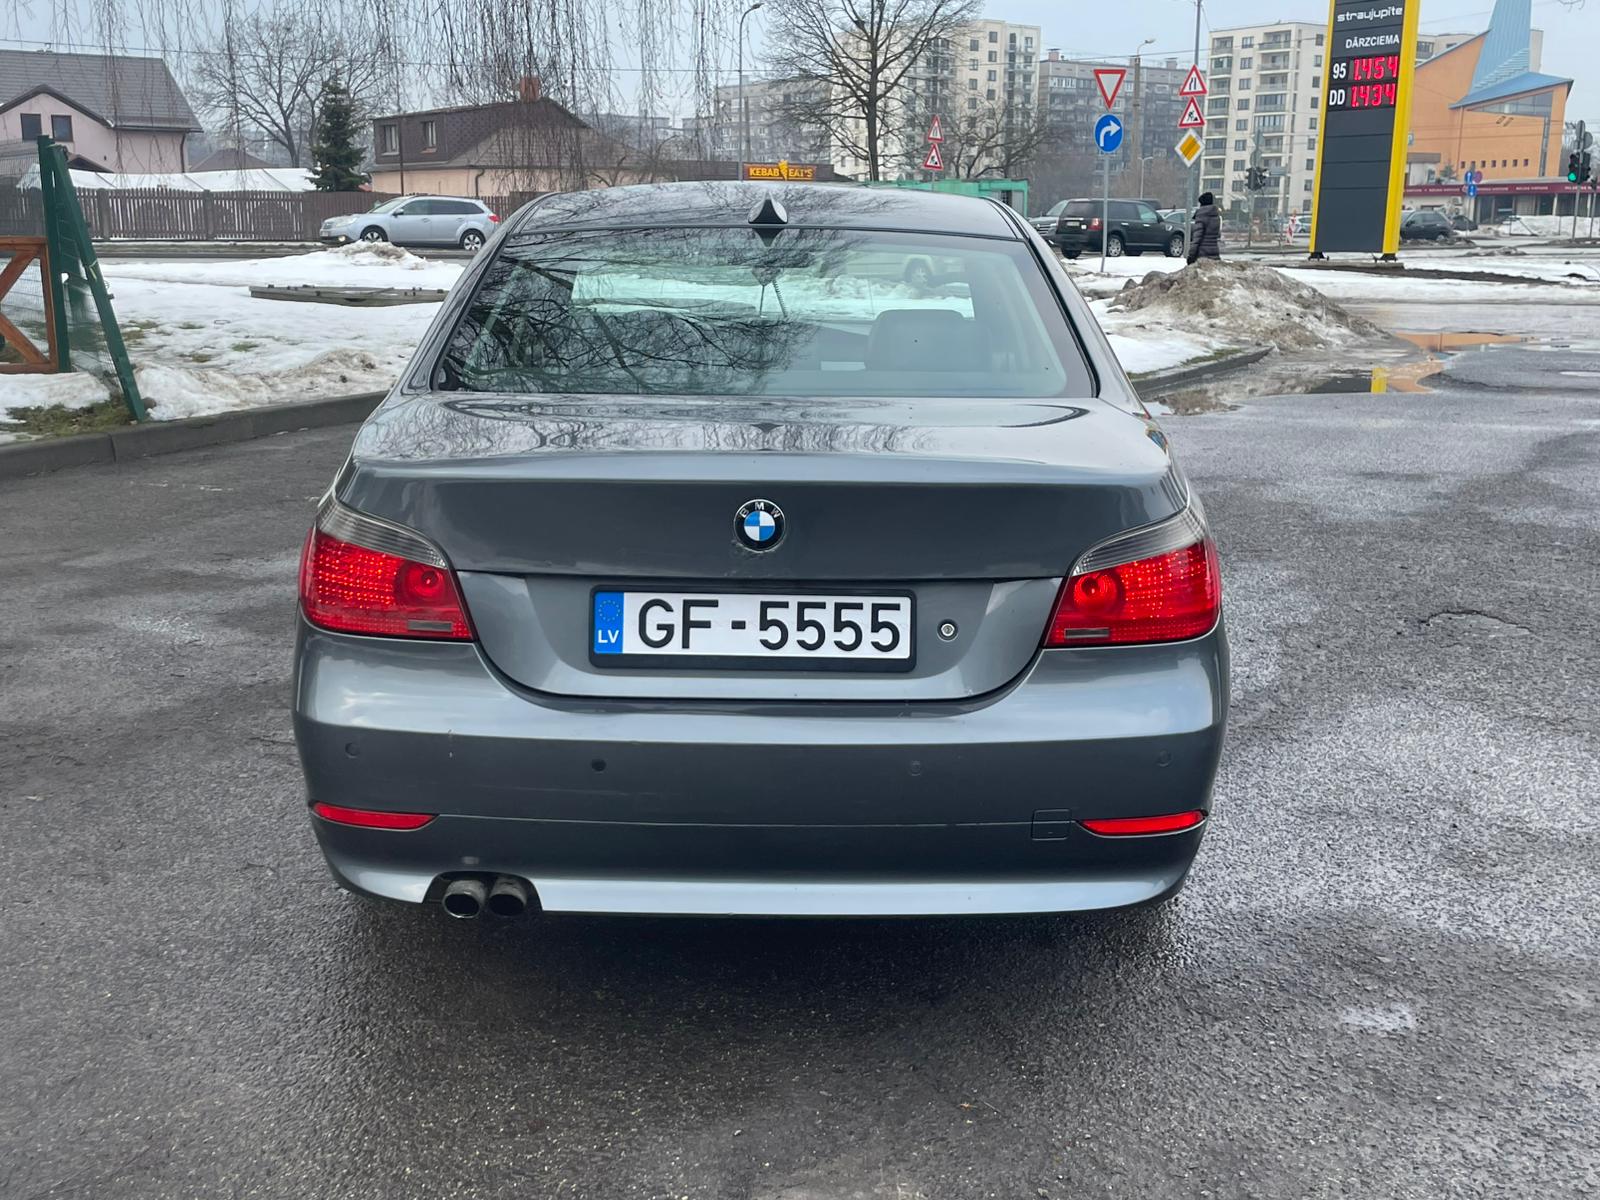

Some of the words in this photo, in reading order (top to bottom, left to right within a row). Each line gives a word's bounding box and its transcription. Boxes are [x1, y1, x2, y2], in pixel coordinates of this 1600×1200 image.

[1345, 34, 1400, 48] DĀRZCIEMA
[1333, 62, 1347, 79] 95
[1329, 88, 1346, 106] DD
[749, 167, 780, 177] KEBAB
[739, 501, 781, 519] BMW
[597, 629, 620, 644] LV
